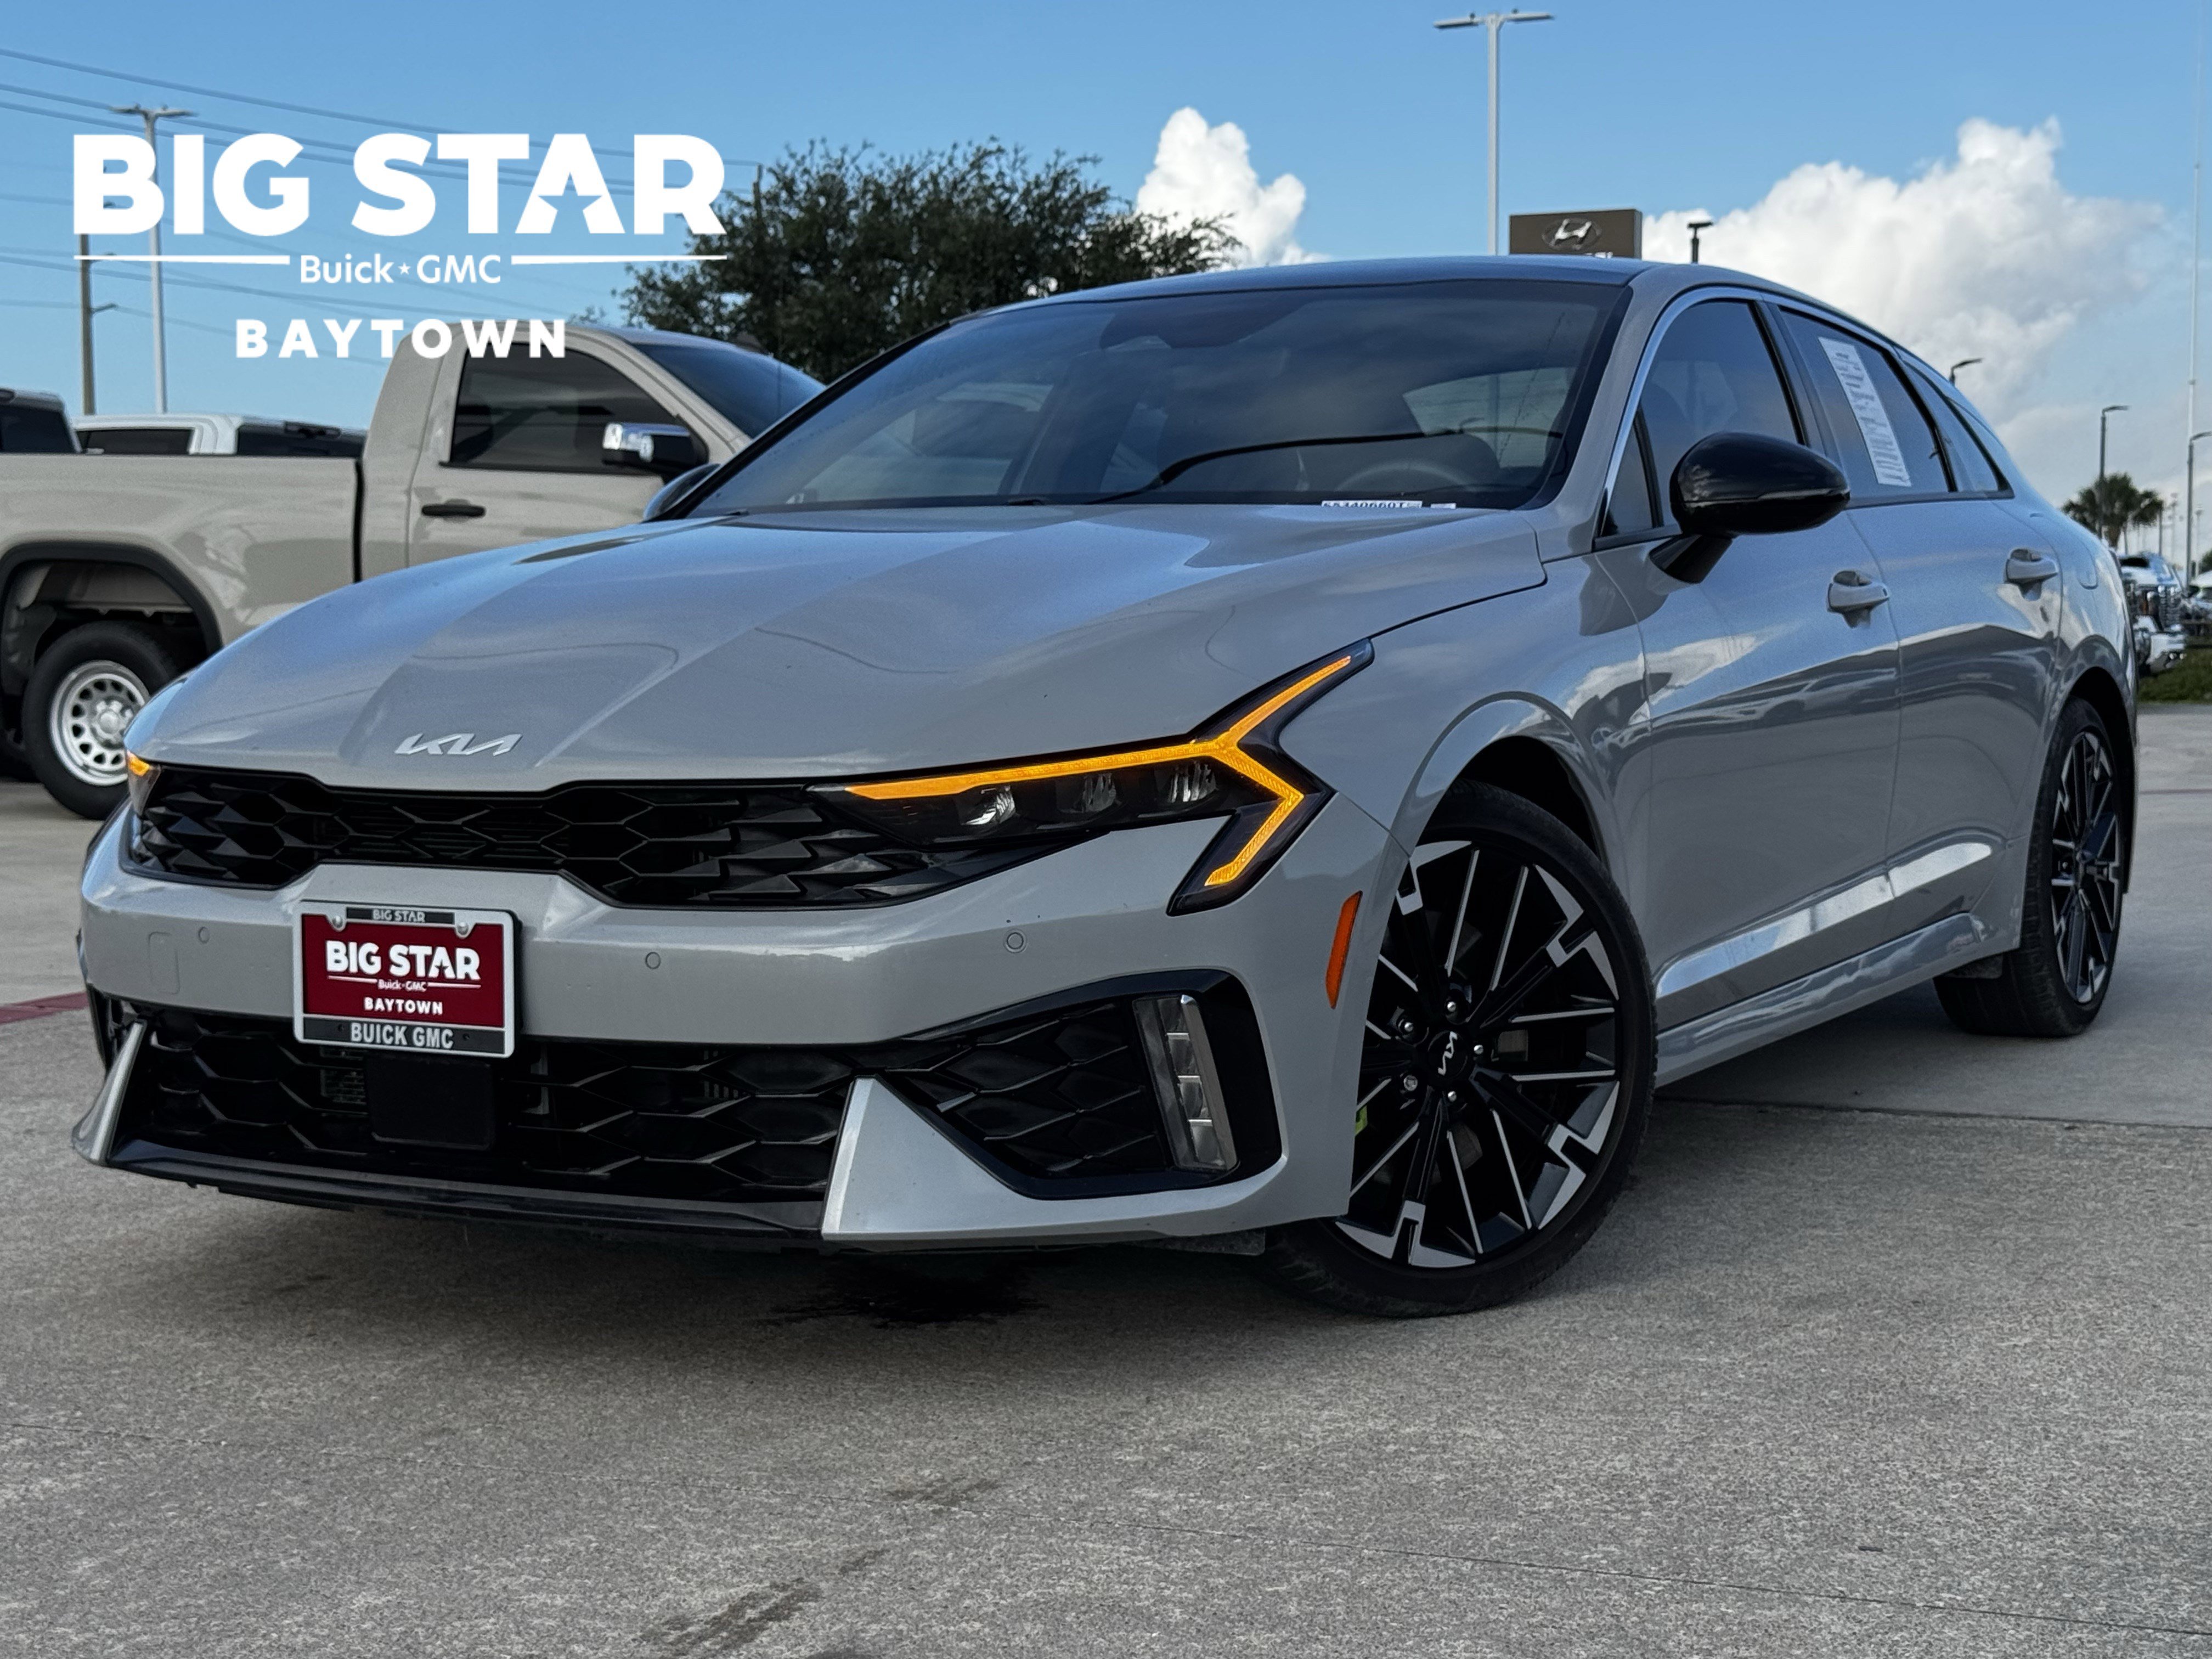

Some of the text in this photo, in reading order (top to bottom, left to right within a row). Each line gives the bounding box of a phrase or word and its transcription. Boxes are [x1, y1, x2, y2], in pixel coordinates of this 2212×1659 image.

[372, 908, 426, 923] BIG STAR
[326, 940, 481, 980] BIG STAR
[377, 979, 427, 992] Buick GMC
[364, 997, 443, 1015] BAYTOWN
[351, 1023, 454, 1049] BUICK GMC
